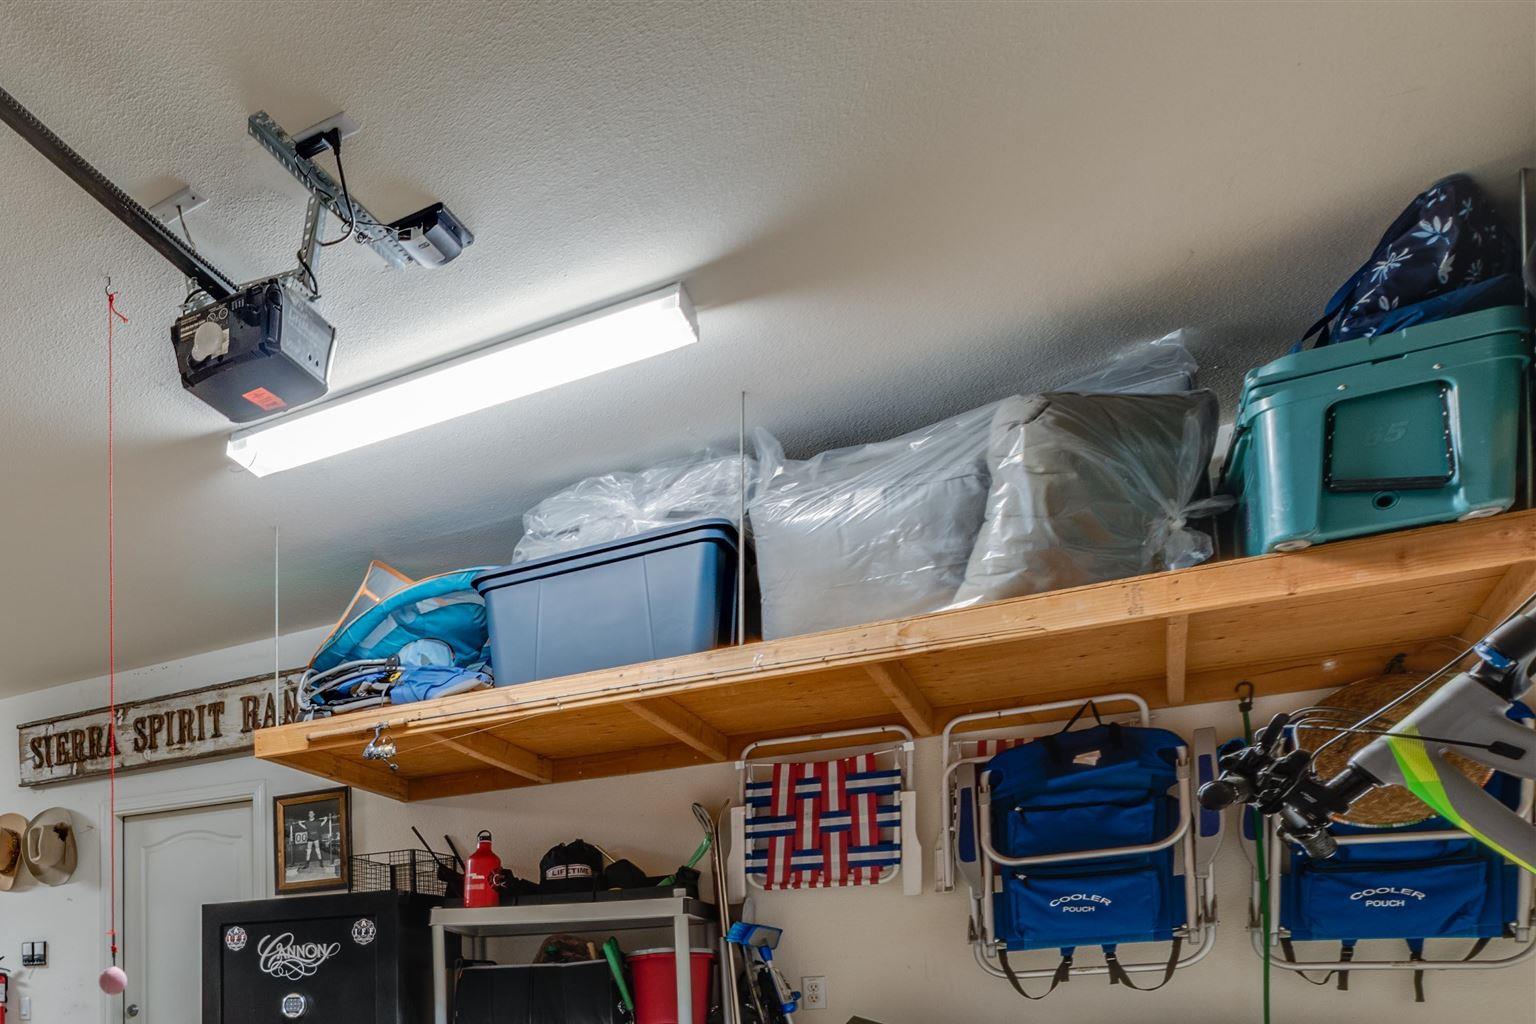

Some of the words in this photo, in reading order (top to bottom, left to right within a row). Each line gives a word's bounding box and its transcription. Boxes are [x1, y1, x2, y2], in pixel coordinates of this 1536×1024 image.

[30, 722, 121, 770] SIERRA
[134, 701, 225, 752] SPIRIT
[240, 688, 300, 734] RAN
[552, 866, 590, 877] LIFTIME
[1049, 894, 1112, 906] COOLER
[1350, 887, 1426, 900] COOLER
[258, 932, 340, 975] CANNON
